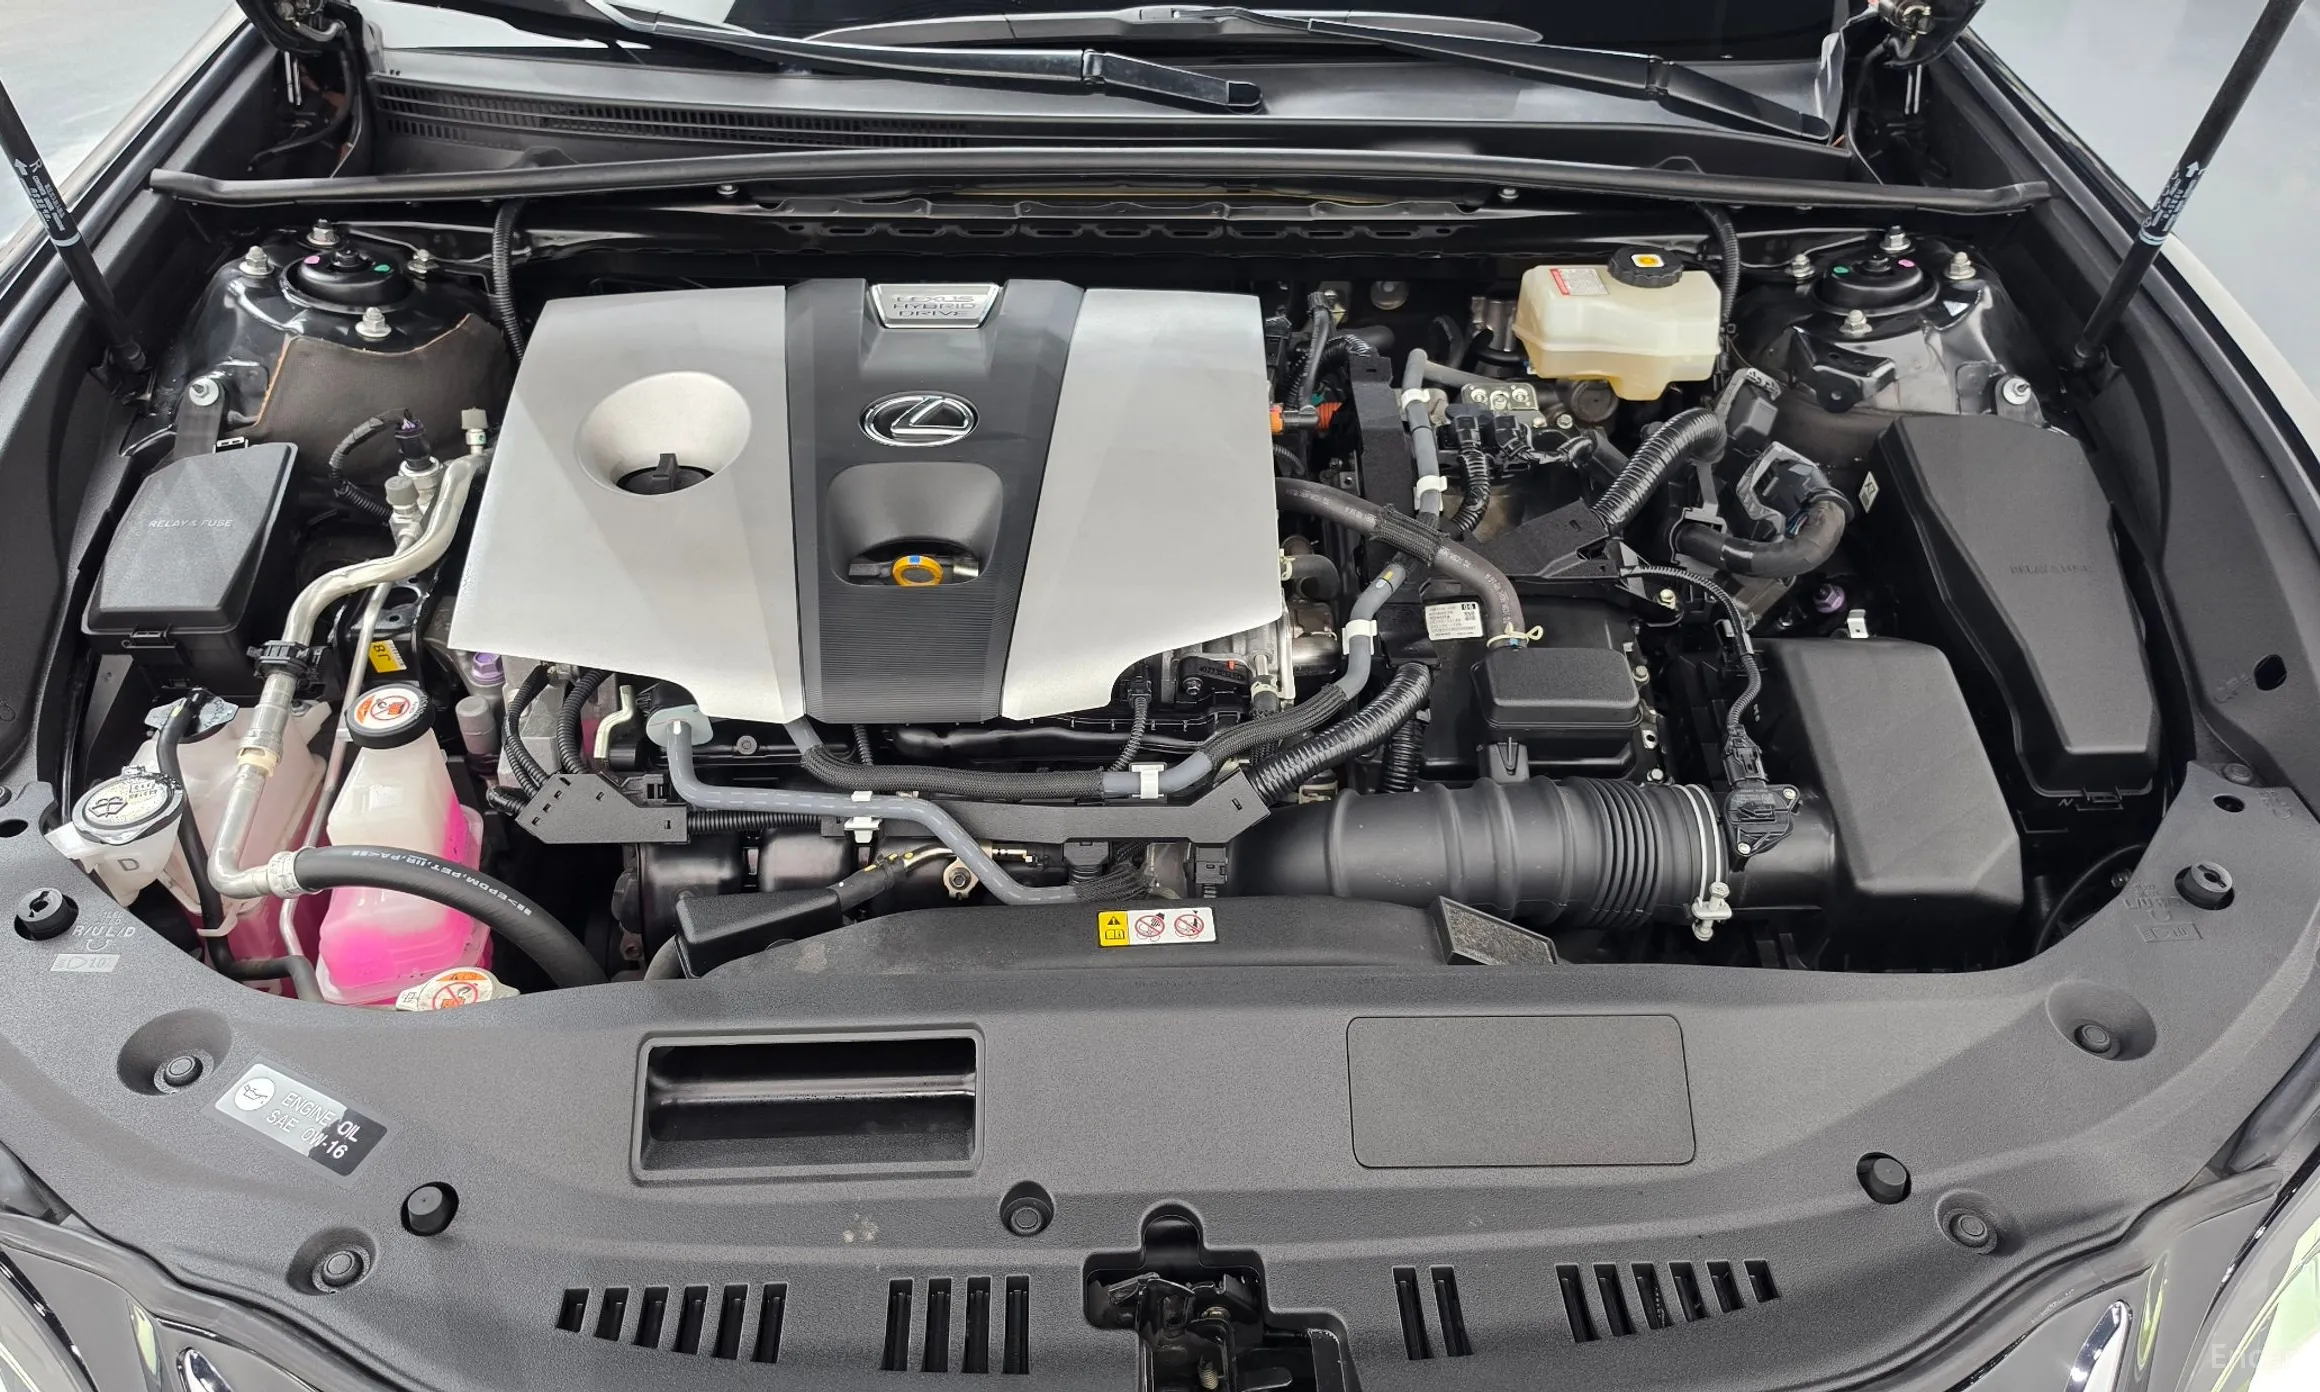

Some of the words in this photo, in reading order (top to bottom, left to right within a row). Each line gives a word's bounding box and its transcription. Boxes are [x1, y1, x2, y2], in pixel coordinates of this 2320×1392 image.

[148, 519, 189, 528] RELAY
[200, 519, 234, 528] FUSE
[266, 1109, 299, 1133] SAE
[301, 1127, 349, 1160] 0W-16
[281, 1091, 336, 1128] ENGINE
[337, 1120, 361, 1143] OIL
